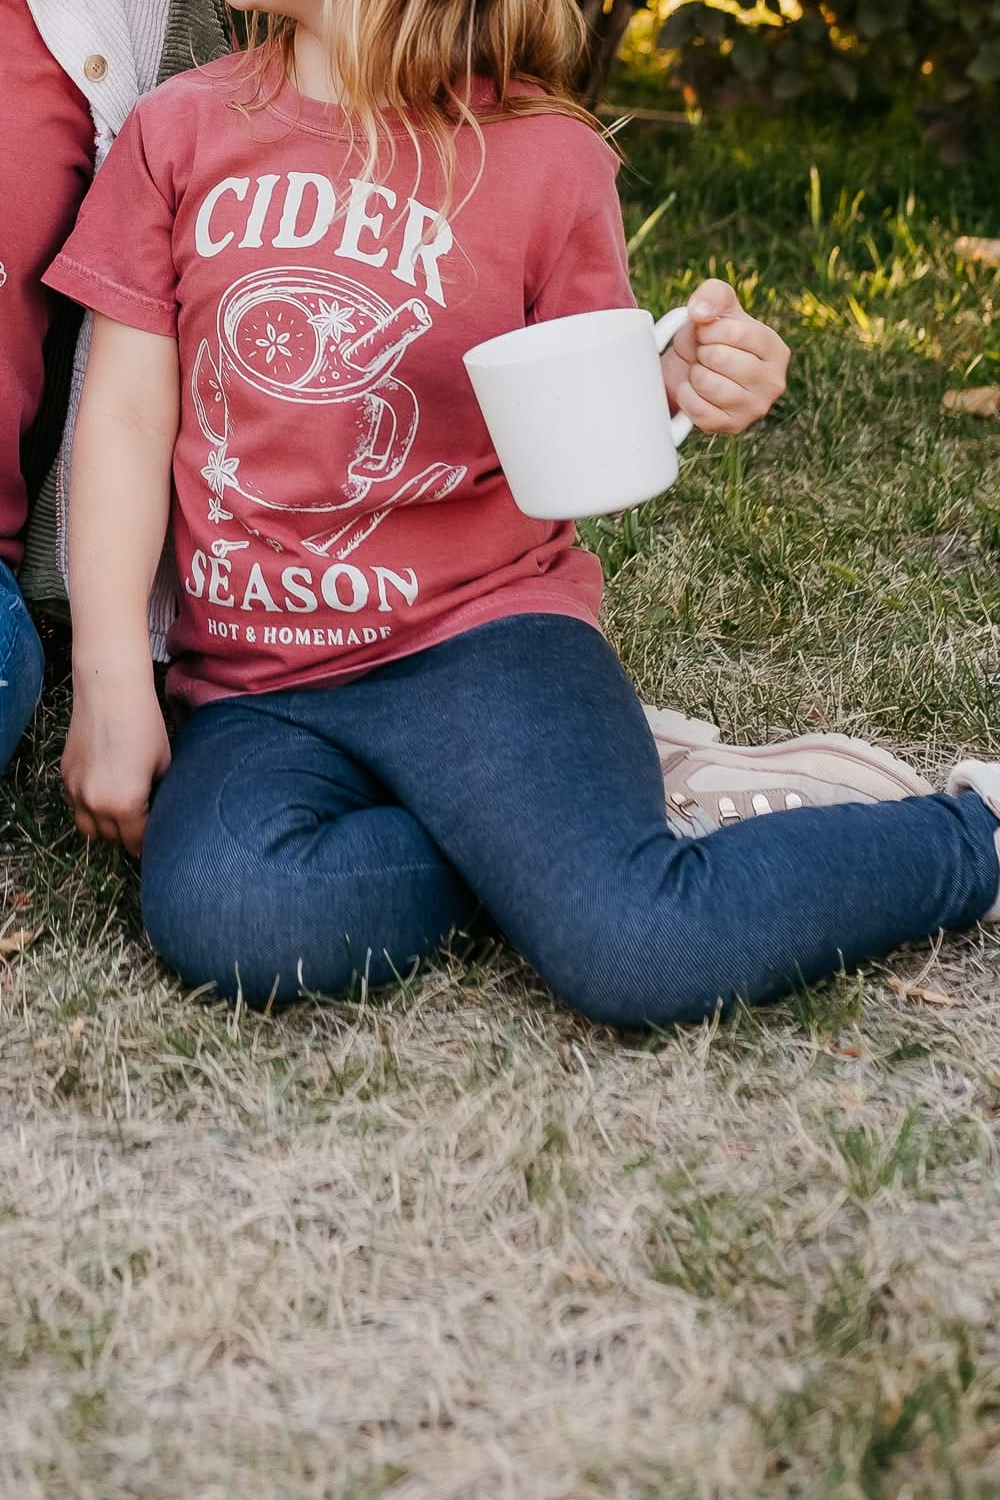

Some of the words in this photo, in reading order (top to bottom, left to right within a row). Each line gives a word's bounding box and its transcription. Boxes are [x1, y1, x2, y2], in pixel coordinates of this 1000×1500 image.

[195, 171, 453, 308] CIDER
[185, 549, 418, 613] SEASON
[208, 618, 240, 641] HOT
[245, 626, 257, 645] &
[263, 626, 392, 646] HOMEMADE
